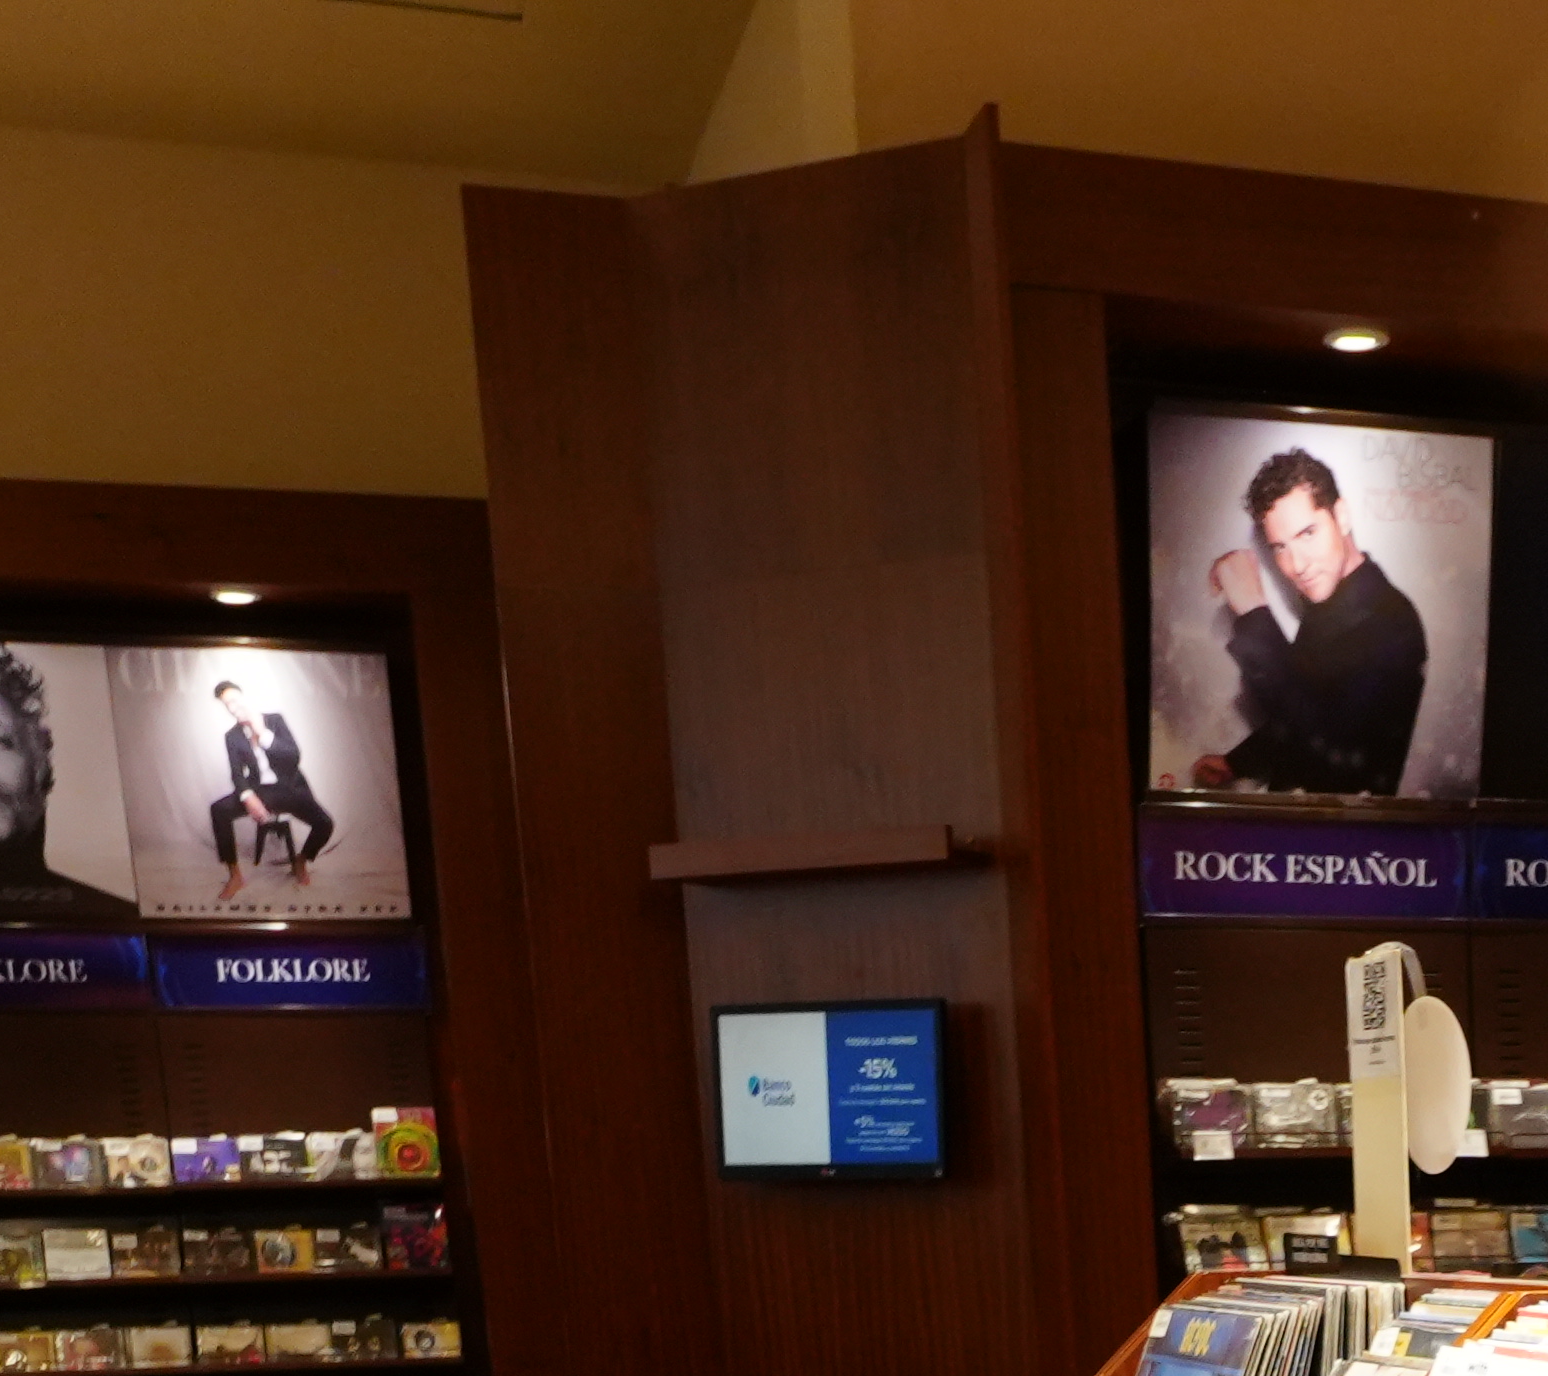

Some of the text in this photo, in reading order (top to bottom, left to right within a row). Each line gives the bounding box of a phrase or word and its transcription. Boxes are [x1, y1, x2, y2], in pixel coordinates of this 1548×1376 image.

[1174, 850, 1437, 888] ROCK ESPAÑOL
[216, 958, 370, 984] FOLKLORE
